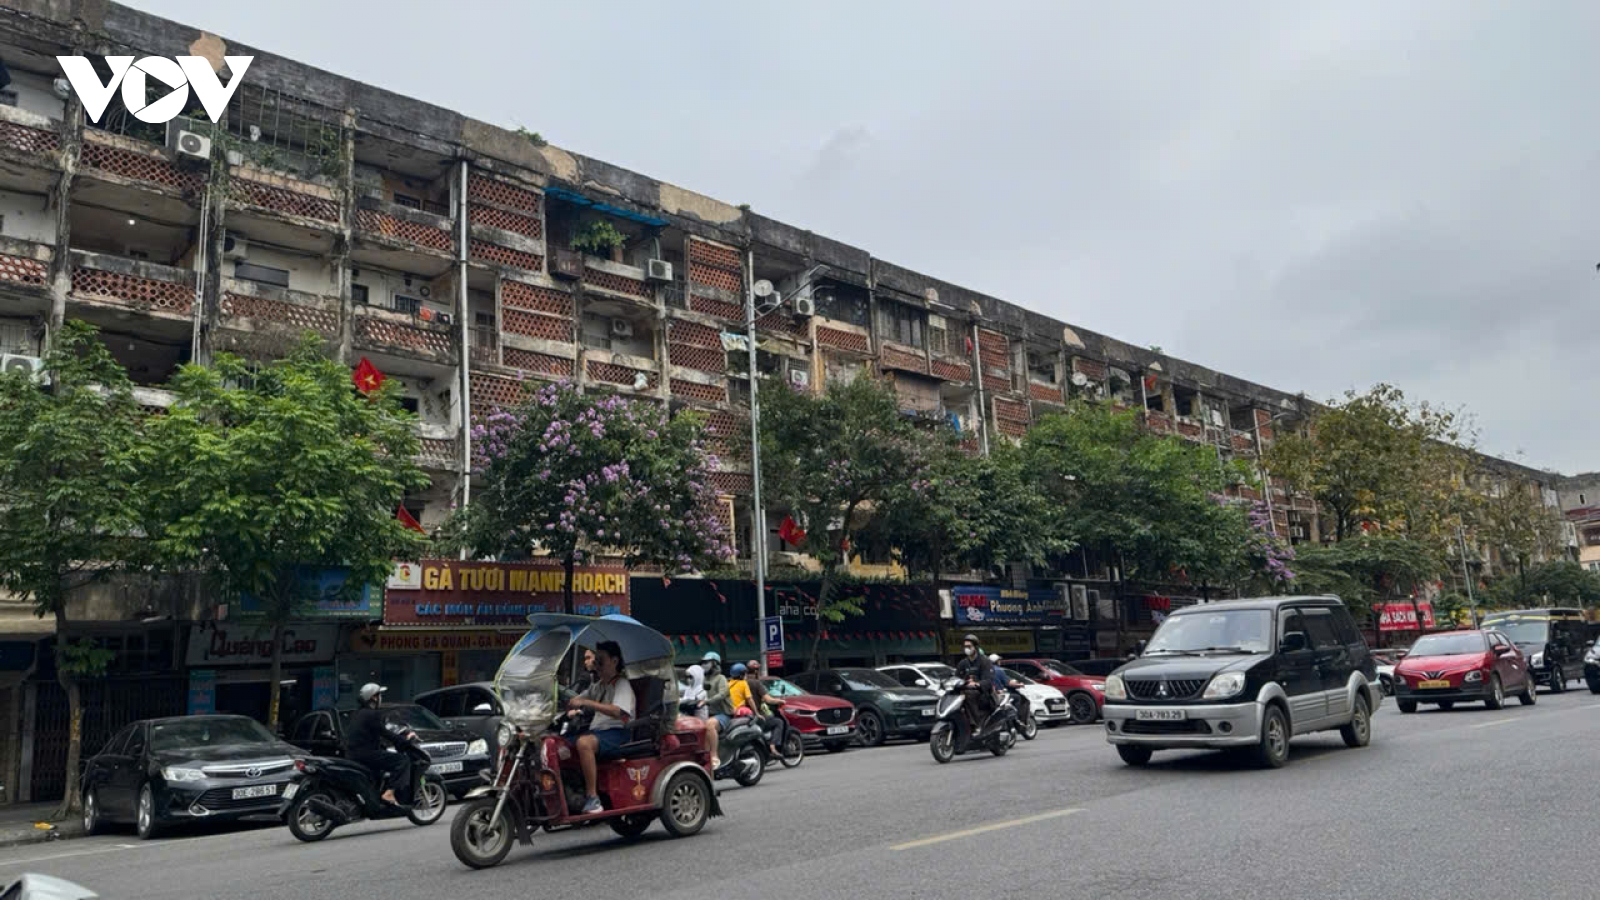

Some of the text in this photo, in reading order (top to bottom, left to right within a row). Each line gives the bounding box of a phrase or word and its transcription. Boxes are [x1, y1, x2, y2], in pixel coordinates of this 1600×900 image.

[424, 563, 453, 590] GÀ
[572, 573, 626, 597] HOẠCH
[780, 600, 799, 616] aha
